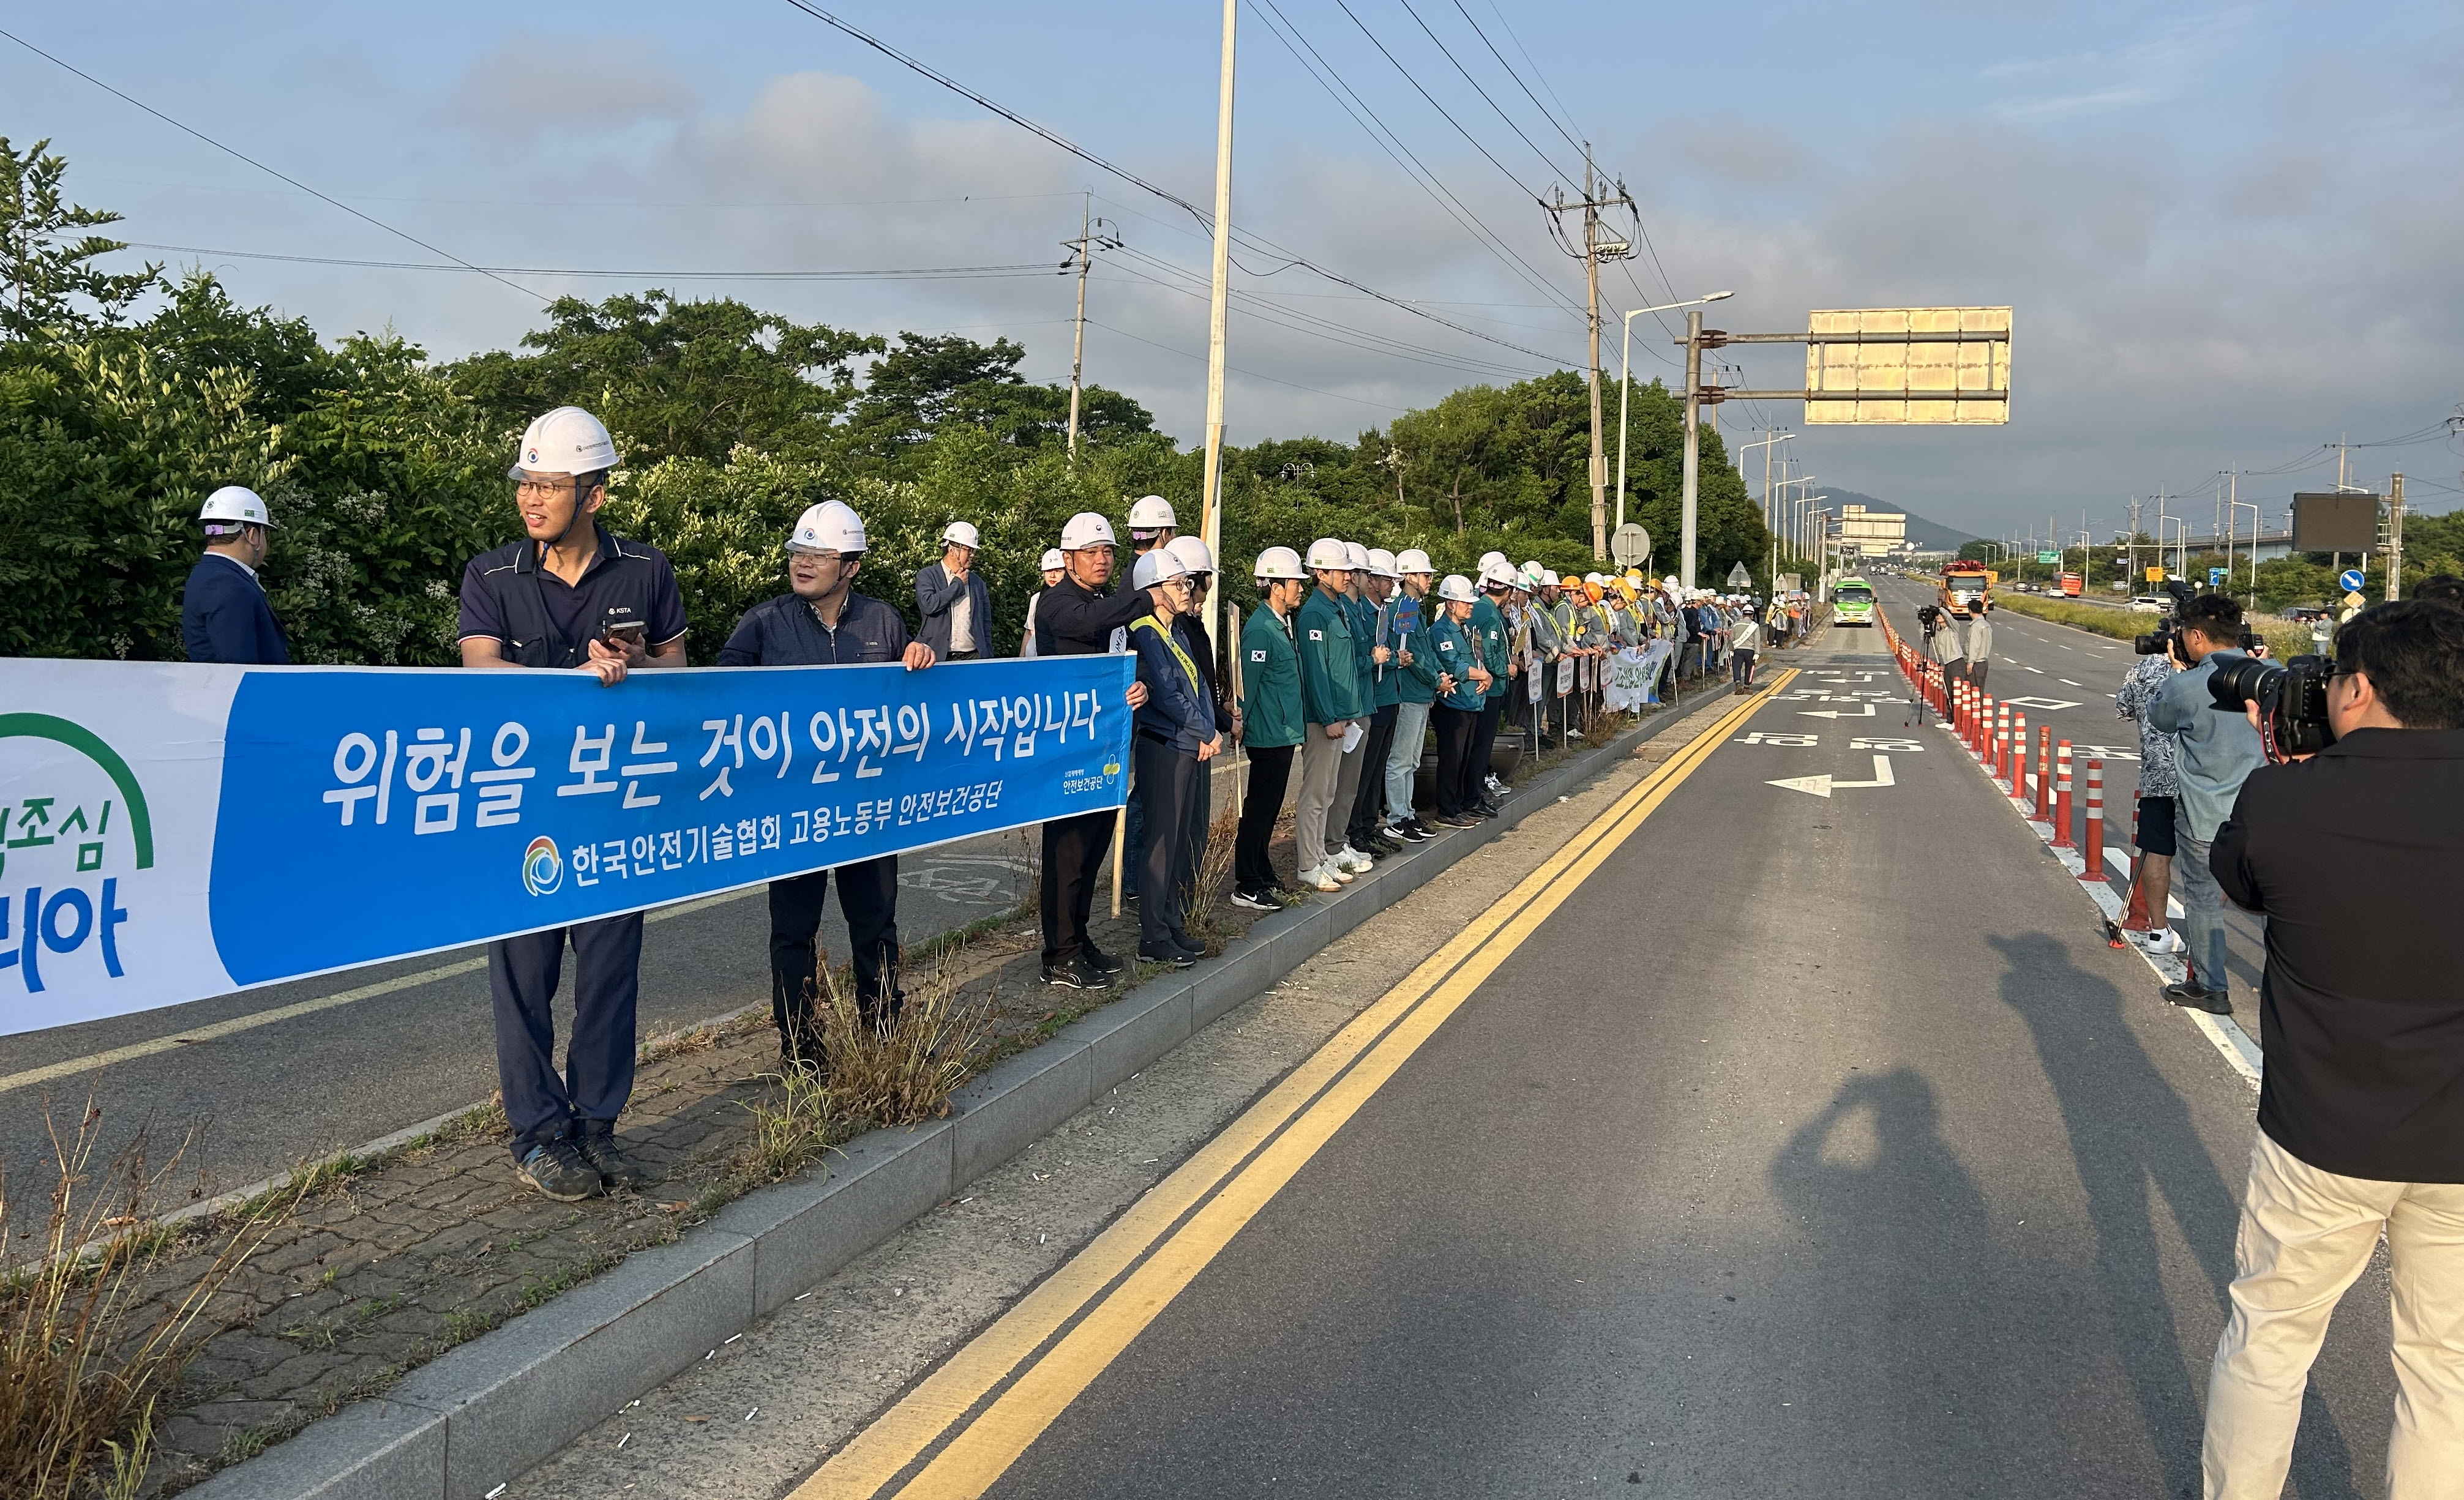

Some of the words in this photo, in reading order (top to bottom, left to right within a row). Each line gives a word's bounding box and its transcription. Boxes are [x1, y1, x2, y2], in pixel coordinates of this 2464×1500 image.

[323, 722, 536, 835] 위험을
[556, 721, 678, 809] 보는
[699, 711, 792, 801] 것이
[809, 702, 930, 784] 안전의
[944, 688, 1101, 761] 시작입니다
[1063, 775, 1104, 795] 안전보건공단
[0, 797, 111, 880] 조심
[572, 814, 781, 887] 한국안전기술협회
[790, 797, 893, 845] 고용노동부
[898, 779, 1004, 826] 안전보건공단
